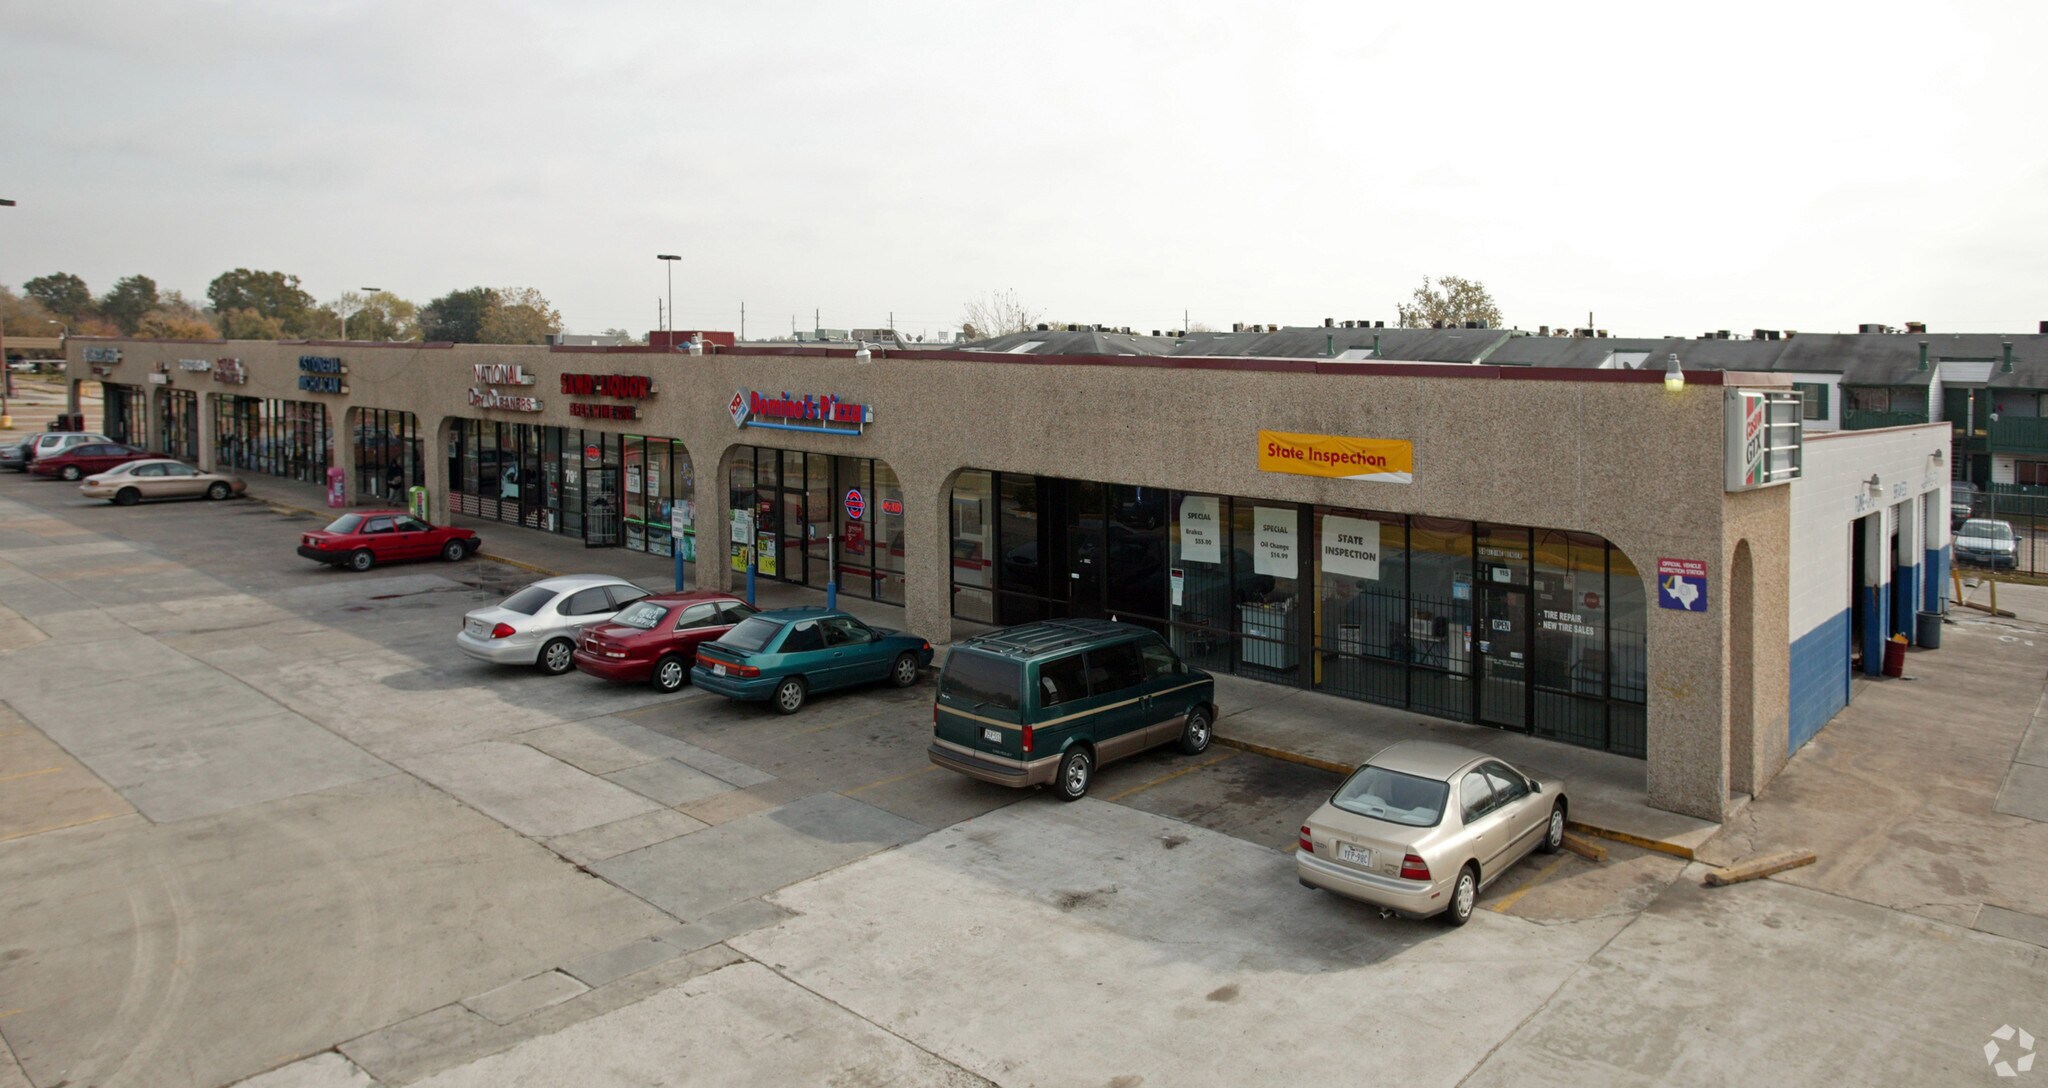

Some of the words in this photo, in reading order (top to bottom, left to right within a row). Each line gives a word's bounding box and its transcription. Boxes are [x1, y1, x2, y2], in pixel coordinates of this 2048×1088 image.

[474, 364, 522, 385] NATIONAL
[601, 374, 650, 400] LIQUOR
[750, 391, 815, 419] Domino's
[820, 393, 862, 423] Pizza
[1268, 443, 1304, 461] State
[1309, 447, 1387, 467] Inspection
[1746, 432, 1761, 465] GTX
[1187, 512, 1212, 521] SPECIAL
[1263, 524, 1288, 534] SPECIAL
[1260, 541, 1268, 549] Oil
[1269, 542, 1289, 551] Change
[1338, 534, 1364, 546] STATE
[1325, 546, 1377, 562] INSPECTION
[1660, 566, 1685, 574] INSPECTION
[1544, 610, 1558, 620] TIRE
[1559, 612, 1582, 623] REPAIR
[1494, 620, 1510, 630] OPEN
[1543, 621, 1558, 630] NEW
[1559, 622, 1573, 632] TIRE
[1573, 624, 1594, 635] SALES
